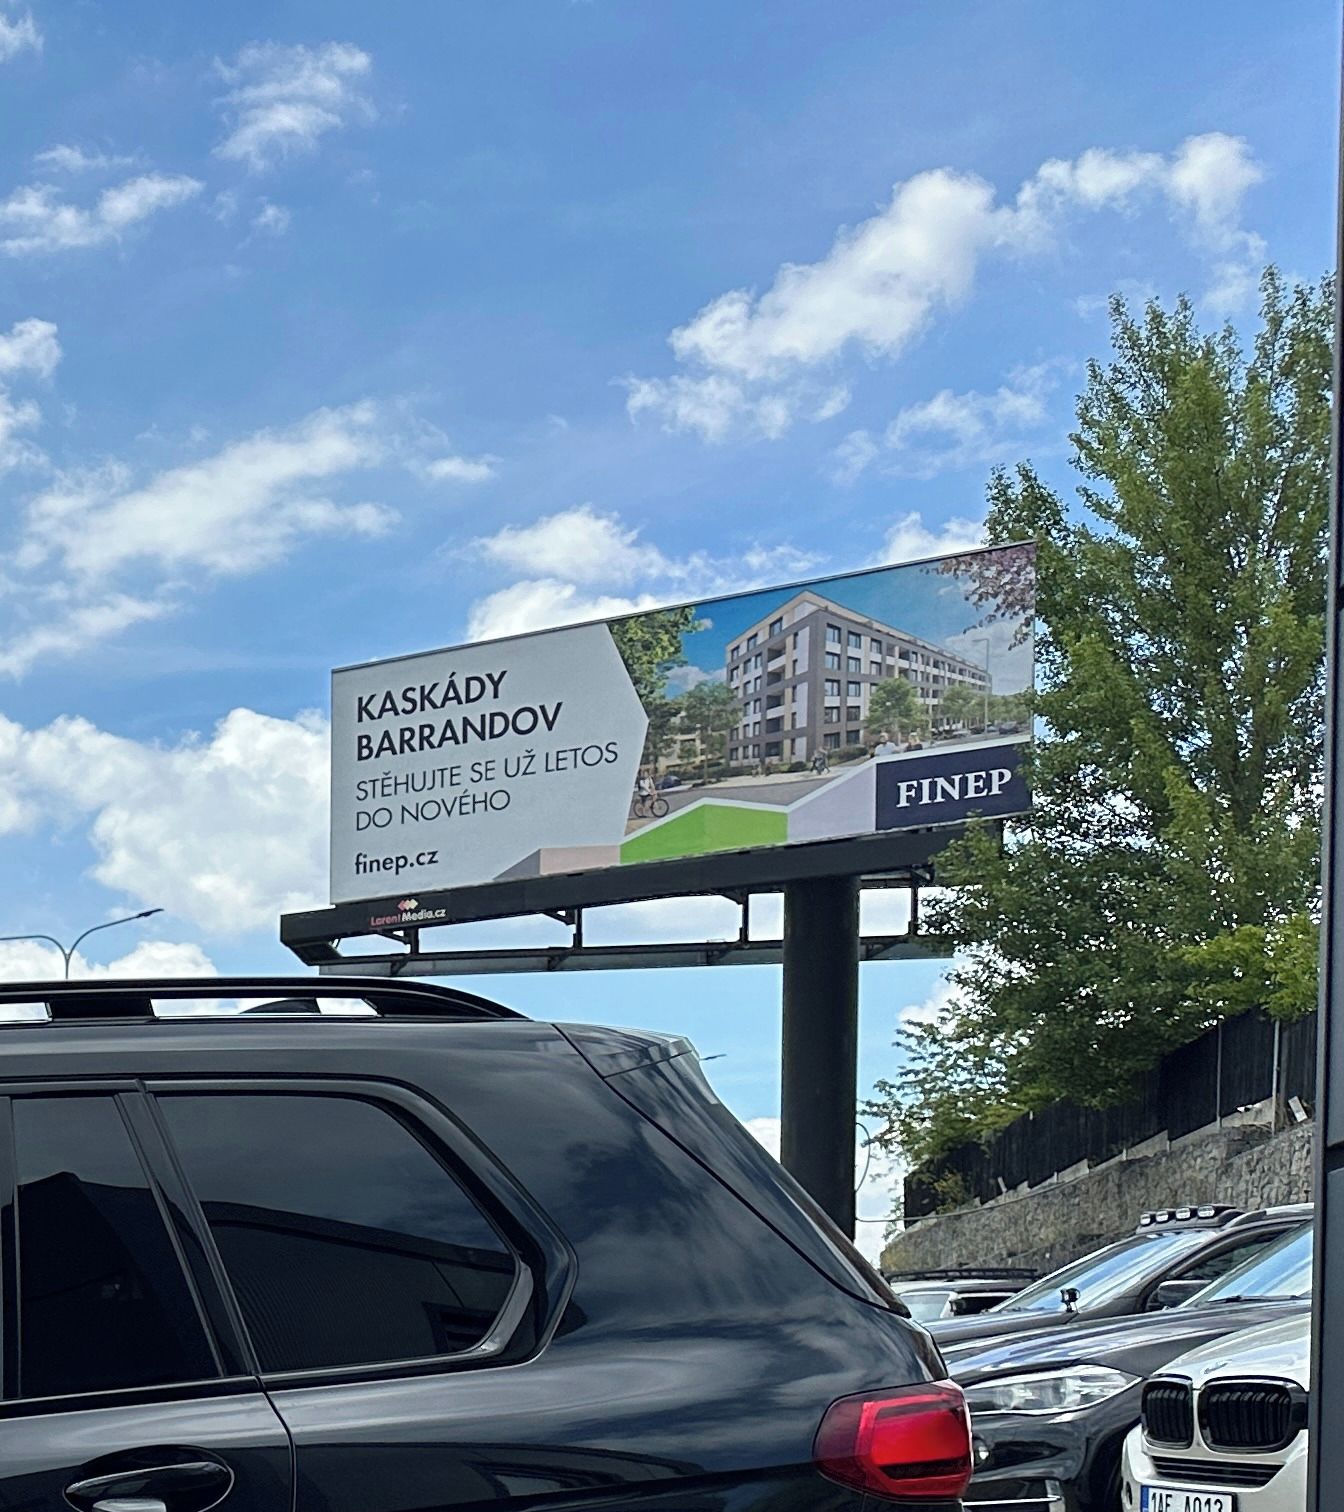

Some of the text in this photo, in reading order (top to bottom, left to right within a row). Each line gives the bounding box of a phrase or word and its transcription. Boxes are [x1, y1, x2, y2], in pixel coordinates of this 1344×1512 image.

[356, 670, 508, 723] KASKÁDY
[356, 701, 564, 762] BARRANDOV
[355, 741, 619, 802] STĚHUJTE SE UŽ LETOS
[896, 768, 1012, 808] FINEP
[356, 788, 511, 832] DO NOVÉHO
[355, 850, 440, 876] finep.cz
